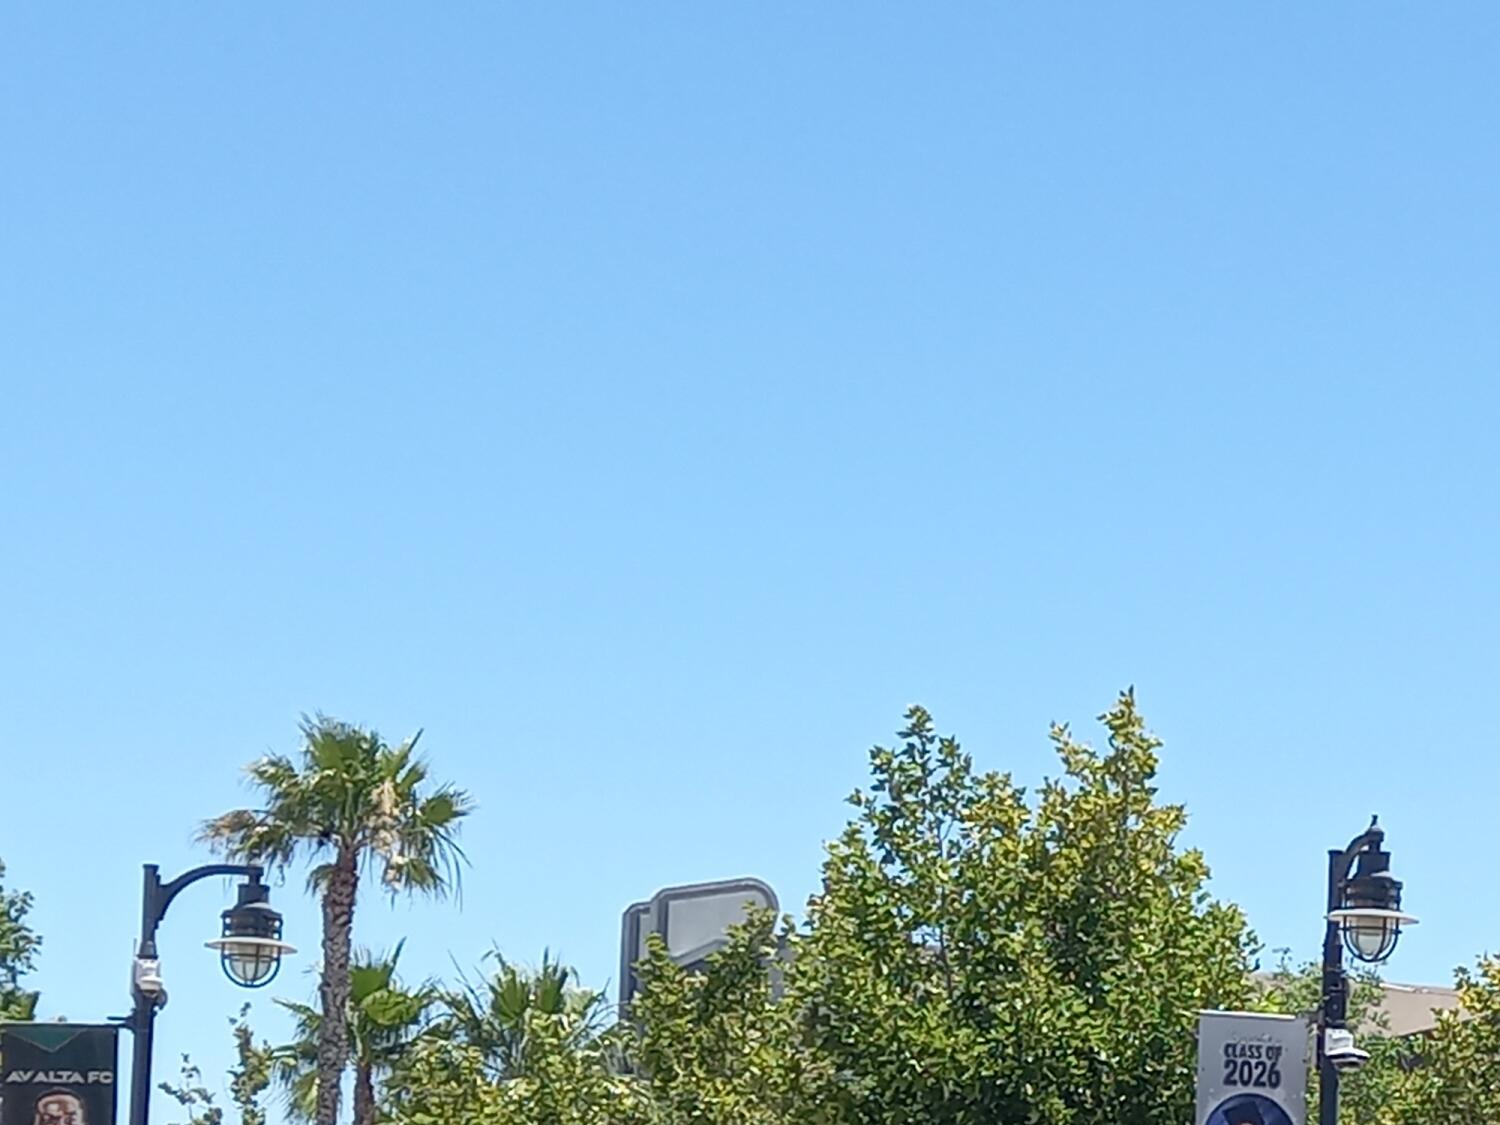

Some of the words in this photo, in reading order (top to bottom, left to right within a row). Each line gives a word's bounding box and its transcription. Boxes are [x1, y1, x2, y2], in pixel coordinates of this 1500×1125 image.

[1223, 1043, 1262, 1059] CLASS
[1265, 1046, 1282, 1061] OF
[87, 1071, 113, 1084] FC
[1223, 1060, 1281, 1088] 2026
